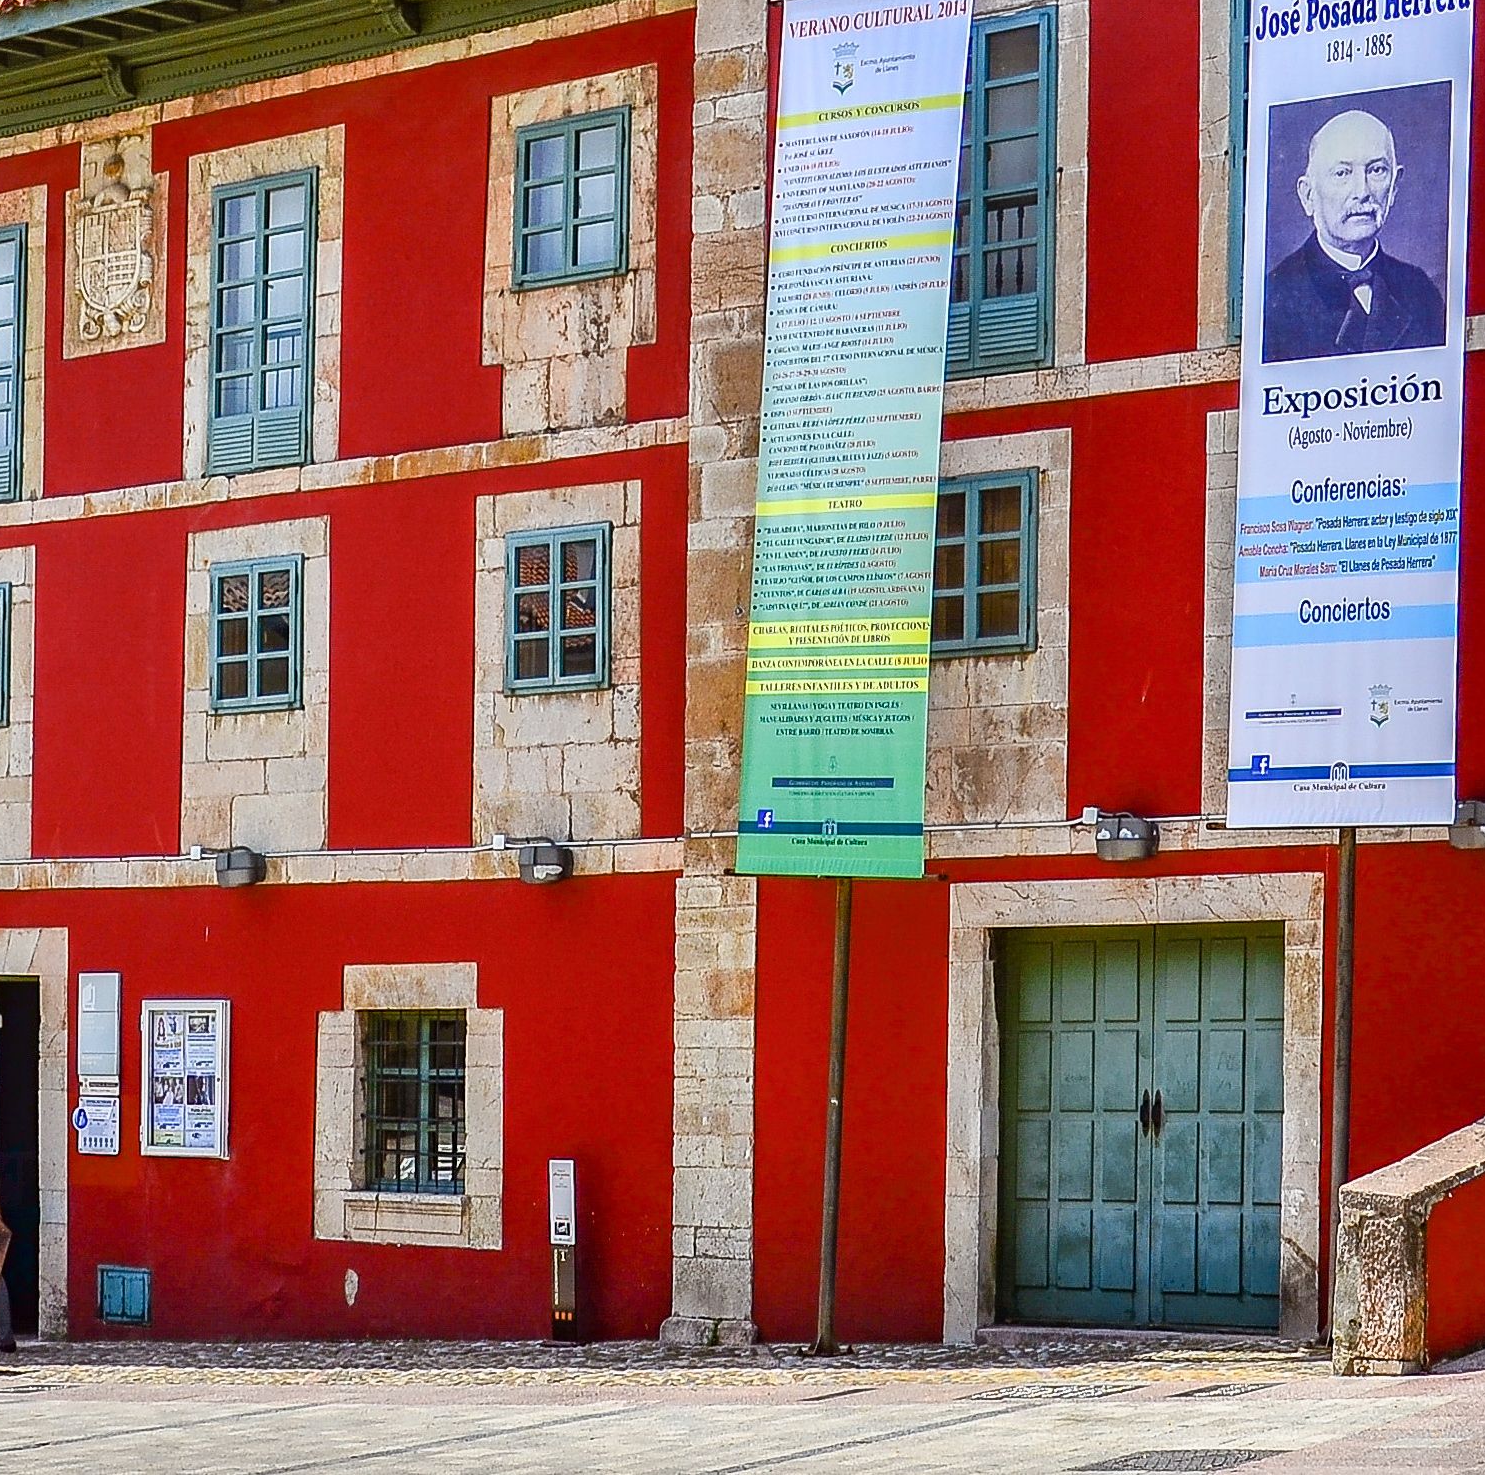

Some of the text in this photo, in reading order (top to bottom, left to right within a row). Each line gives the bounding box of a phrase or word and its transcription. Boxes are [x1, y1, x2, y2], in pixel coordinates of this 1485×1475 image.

[789, 14, 849, 38] VERANO
[853, 4, 933, 30] CULTURAL
[1255, 0, 1300, 41] José
[1326, 39, 1353, 63] 1814
[1365, 32, 1393, 58] 1885
[818, 101, 920, 122] CURSOS Y CONCURSOS
[830, 240, 888, 254] CONCIERTOS
[1262, 373, 1443, 418] Exposición
[1288, 417, 1413, 450] (Agosto Noviembre)
[1291, 473, 1407, 504] Conferencias:
[828, 499, 863, 510] TEATRO
[1315, 516, 1342, 530] "Posada
[1418, 510, 1427, 523] de
[1428, 508, 1445, 525] siglo
[1290, 540, 1316, 554] "Posada
[1344, 537, 1367, 550] Llanes
[1367, 538, 1376, 549] en
[1376, 536, 1383, 548] la
[1384, 534, 1397, 551] Ley
[1397, 532, 1429, 549] Municipal
[1429, 532, 1439, 545] de
[1348, 559, 1371, 573] Llanes
[1371, 558, 1380, 571] de
[1380, 556, 1405, 571] Posada
[1298, 595, 1392, 625] Conciertos
[795, 634, 850, 645] PRESENTACIÓN
[851, 635, 860, 644] DE
[862, 634, 891, 643] LIBROS
[752, 660, 776, 669] DANZA
[867, 657, 892, 666] CALLE
[760, 683, 802, 692] TALLERES
[803, 681, 853, 691] INFANTILES
[862, 681, 875, 690] DE
[876, 680, 919, 690] ADULTOS
[1293, 781, 1387, 793] Casa Municipal de Cultura
[791, 838, 806, 846] Casa
[806, 837, 836, 847] Municipal
[845, 837, 868, 846] Cultura
